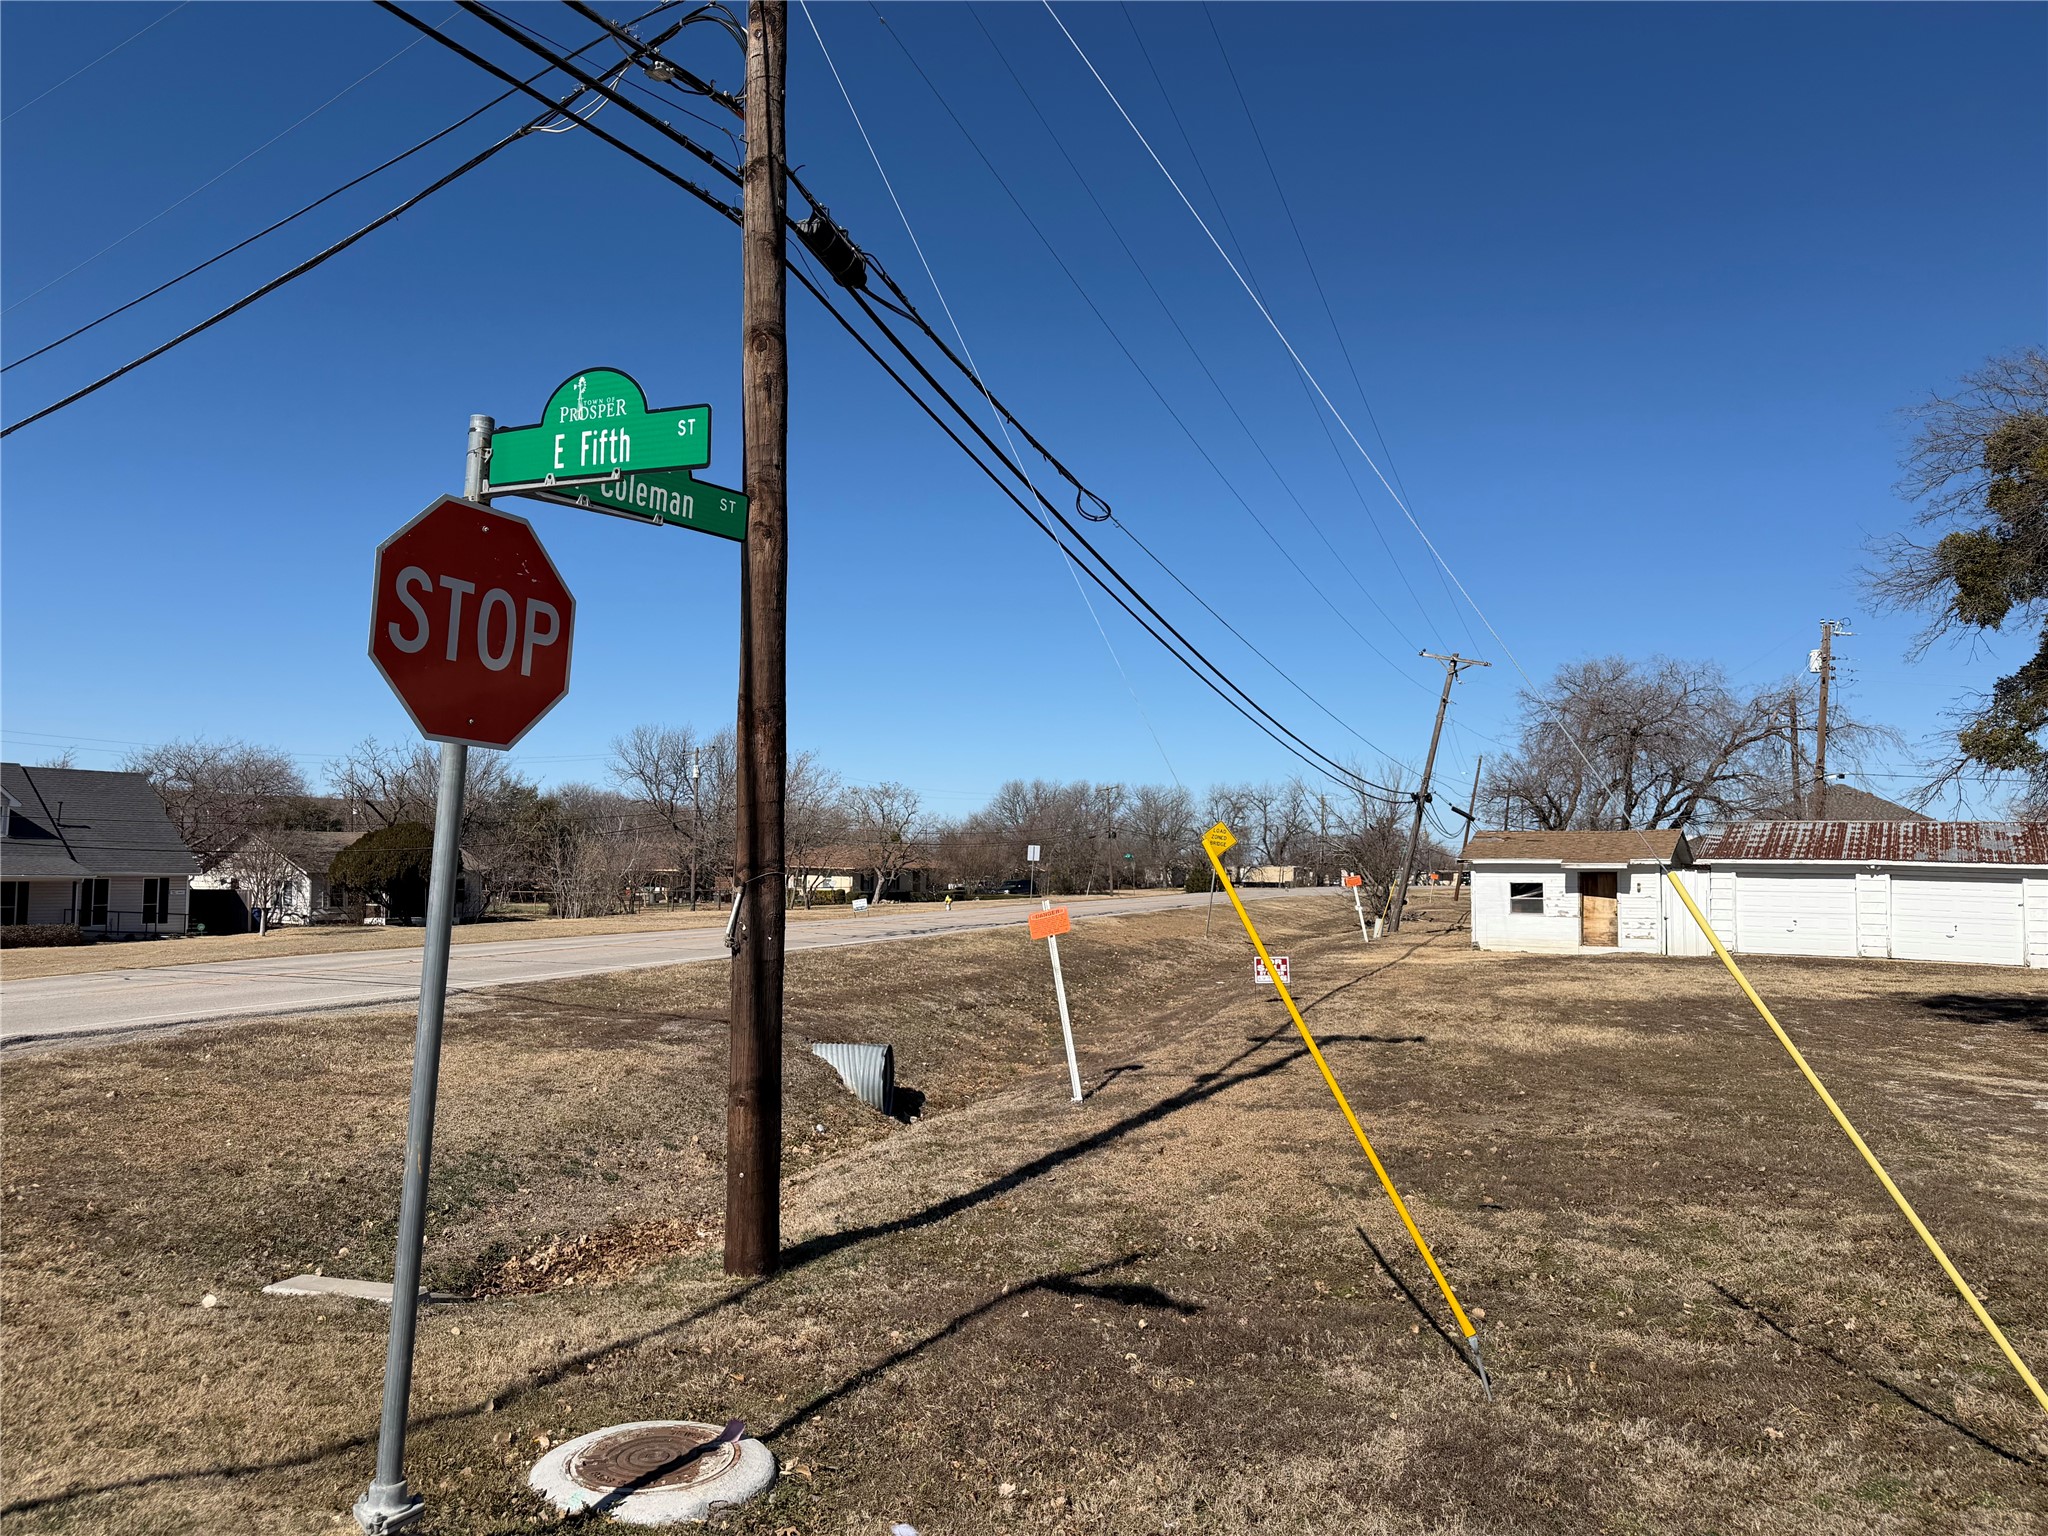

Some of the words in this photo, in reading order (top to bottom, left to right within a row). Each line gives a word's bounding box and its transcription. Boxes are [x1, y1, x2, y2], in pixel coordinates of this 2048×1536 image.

[559, 398, 627, 423] PROSPER
[583, 398, 604, 406] TOWN
[553, 433, 566, 469] E
[580, 427, 631, 466] Fifth
[677, 418, 696, 436] ST
[719, 498, 737, 514] ST
[388, 565, 561, 677] STOP
[1035, 909, 1060, 919] DANGER
